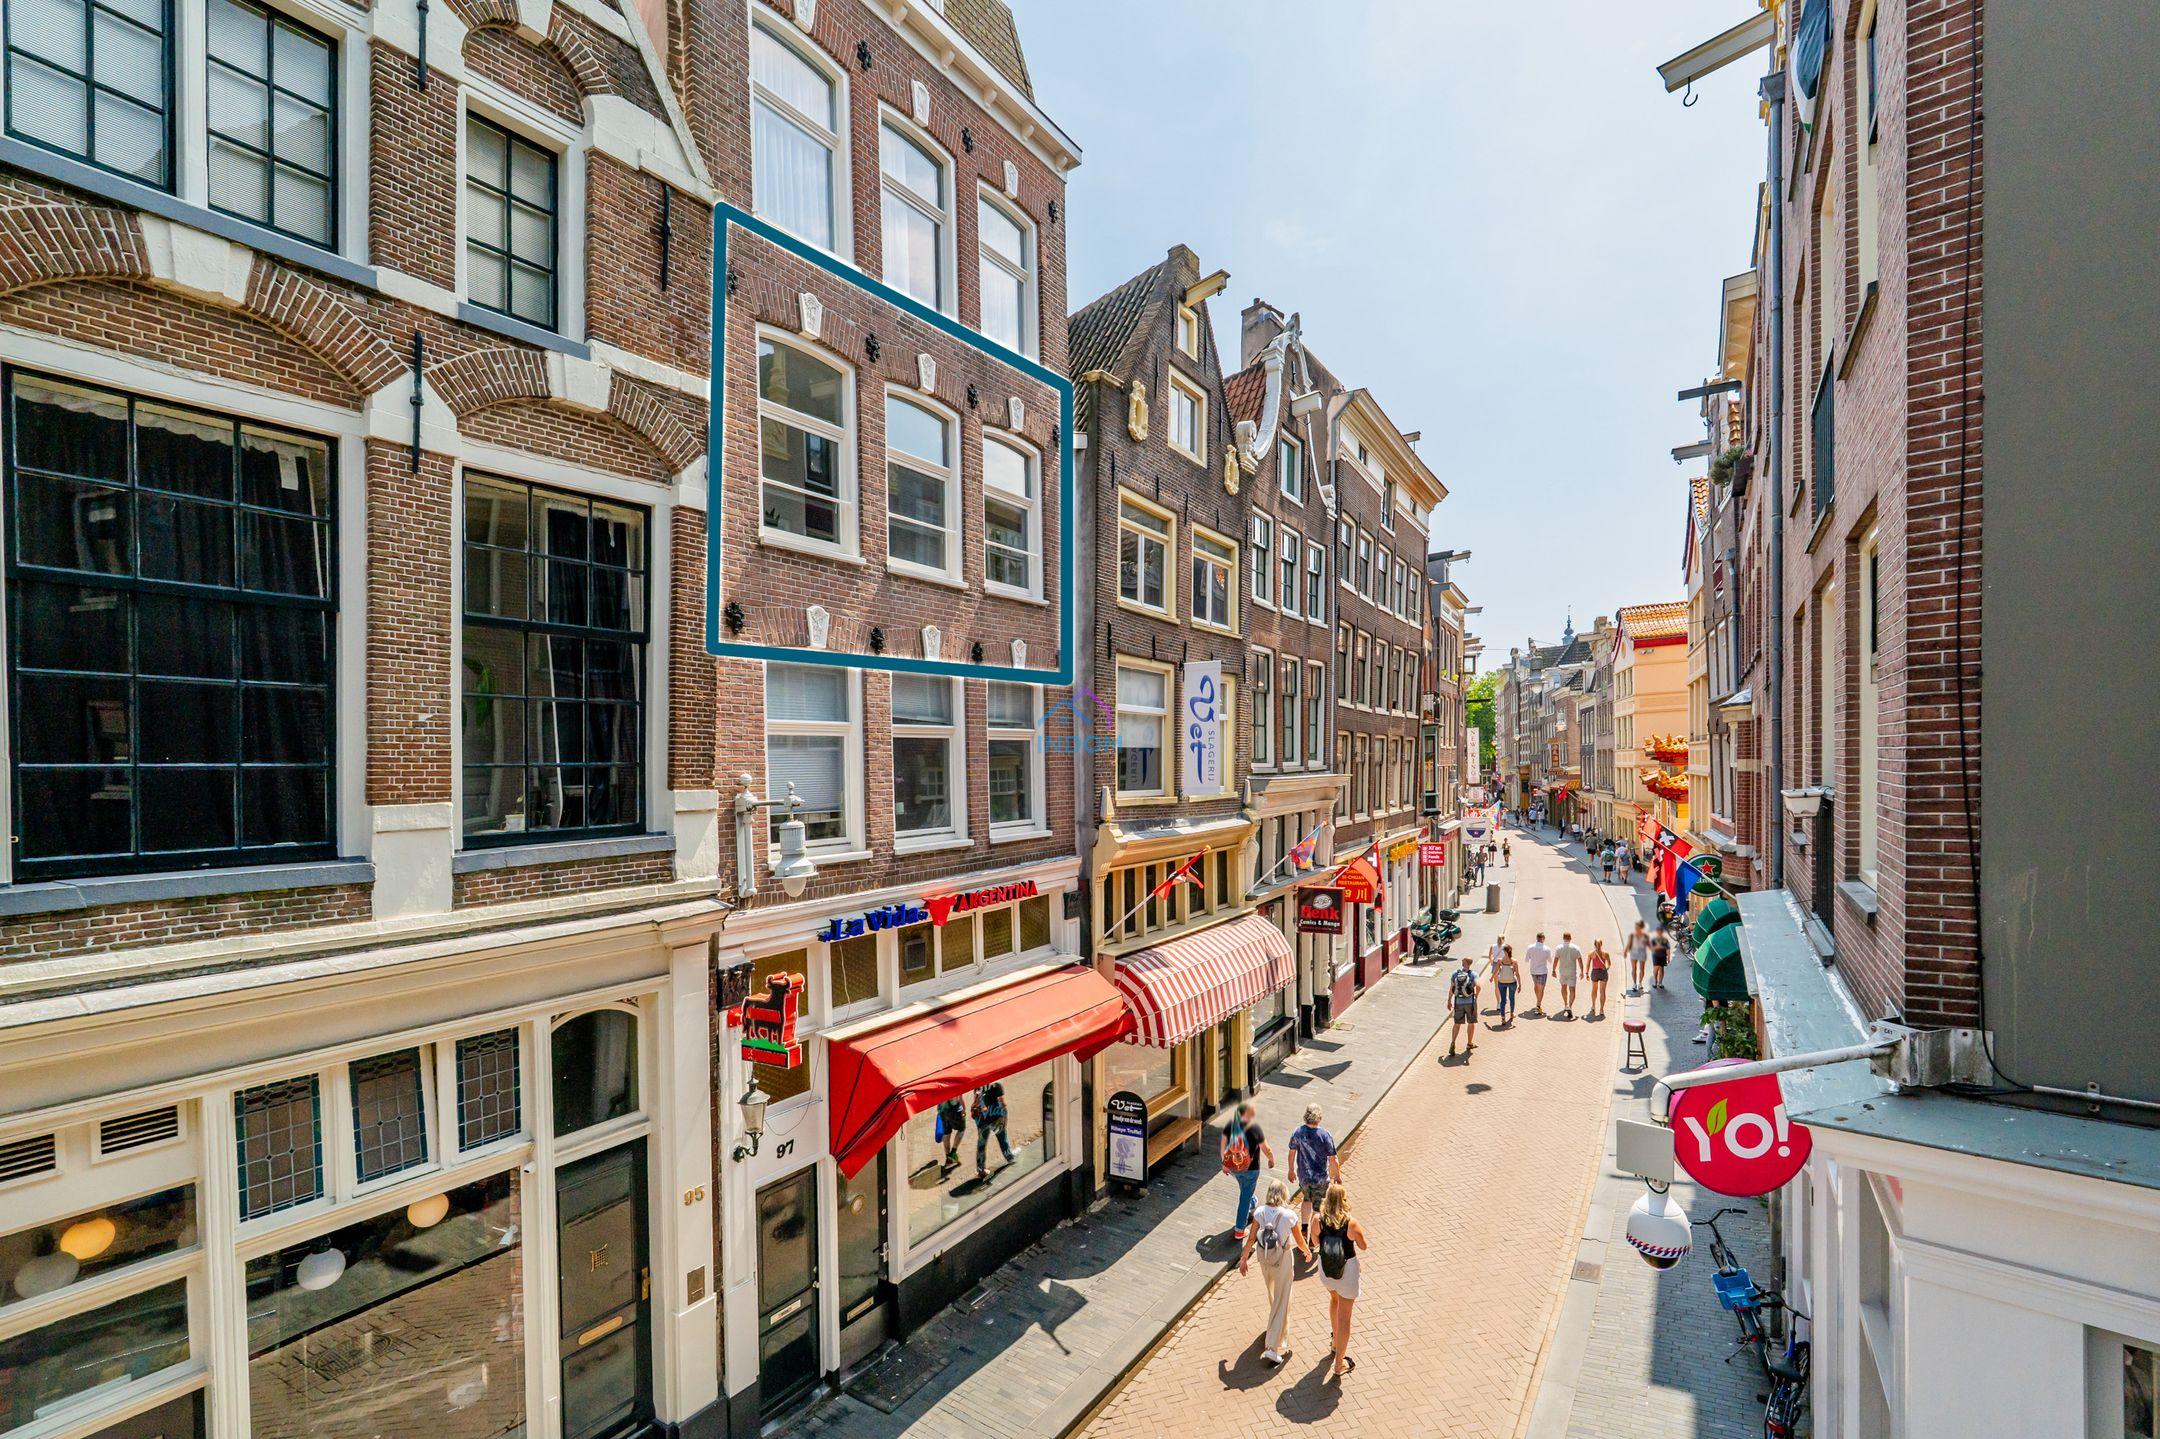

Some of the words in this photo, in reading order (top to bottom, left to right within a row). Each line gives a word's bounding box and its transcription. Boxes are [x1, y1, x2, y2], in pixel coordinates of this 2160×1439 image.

[1189, 674, 1215, 784] Vet
[1207, 730, 1216, 781] SLAGERIJ
[829, 918, 865, 941] La
[864, 903, 920, 932] Vida
[953, 880, 1039, 912] ARGENTINA
[1300, 905, 1340, 919] Henk
[1111, 1099, 1142, 1112] Vet
[776, 1139, 795, 1159] 97
[1683, 1103, 1791, 1162] YO!
[684, 1183, 705, 1206] 95
